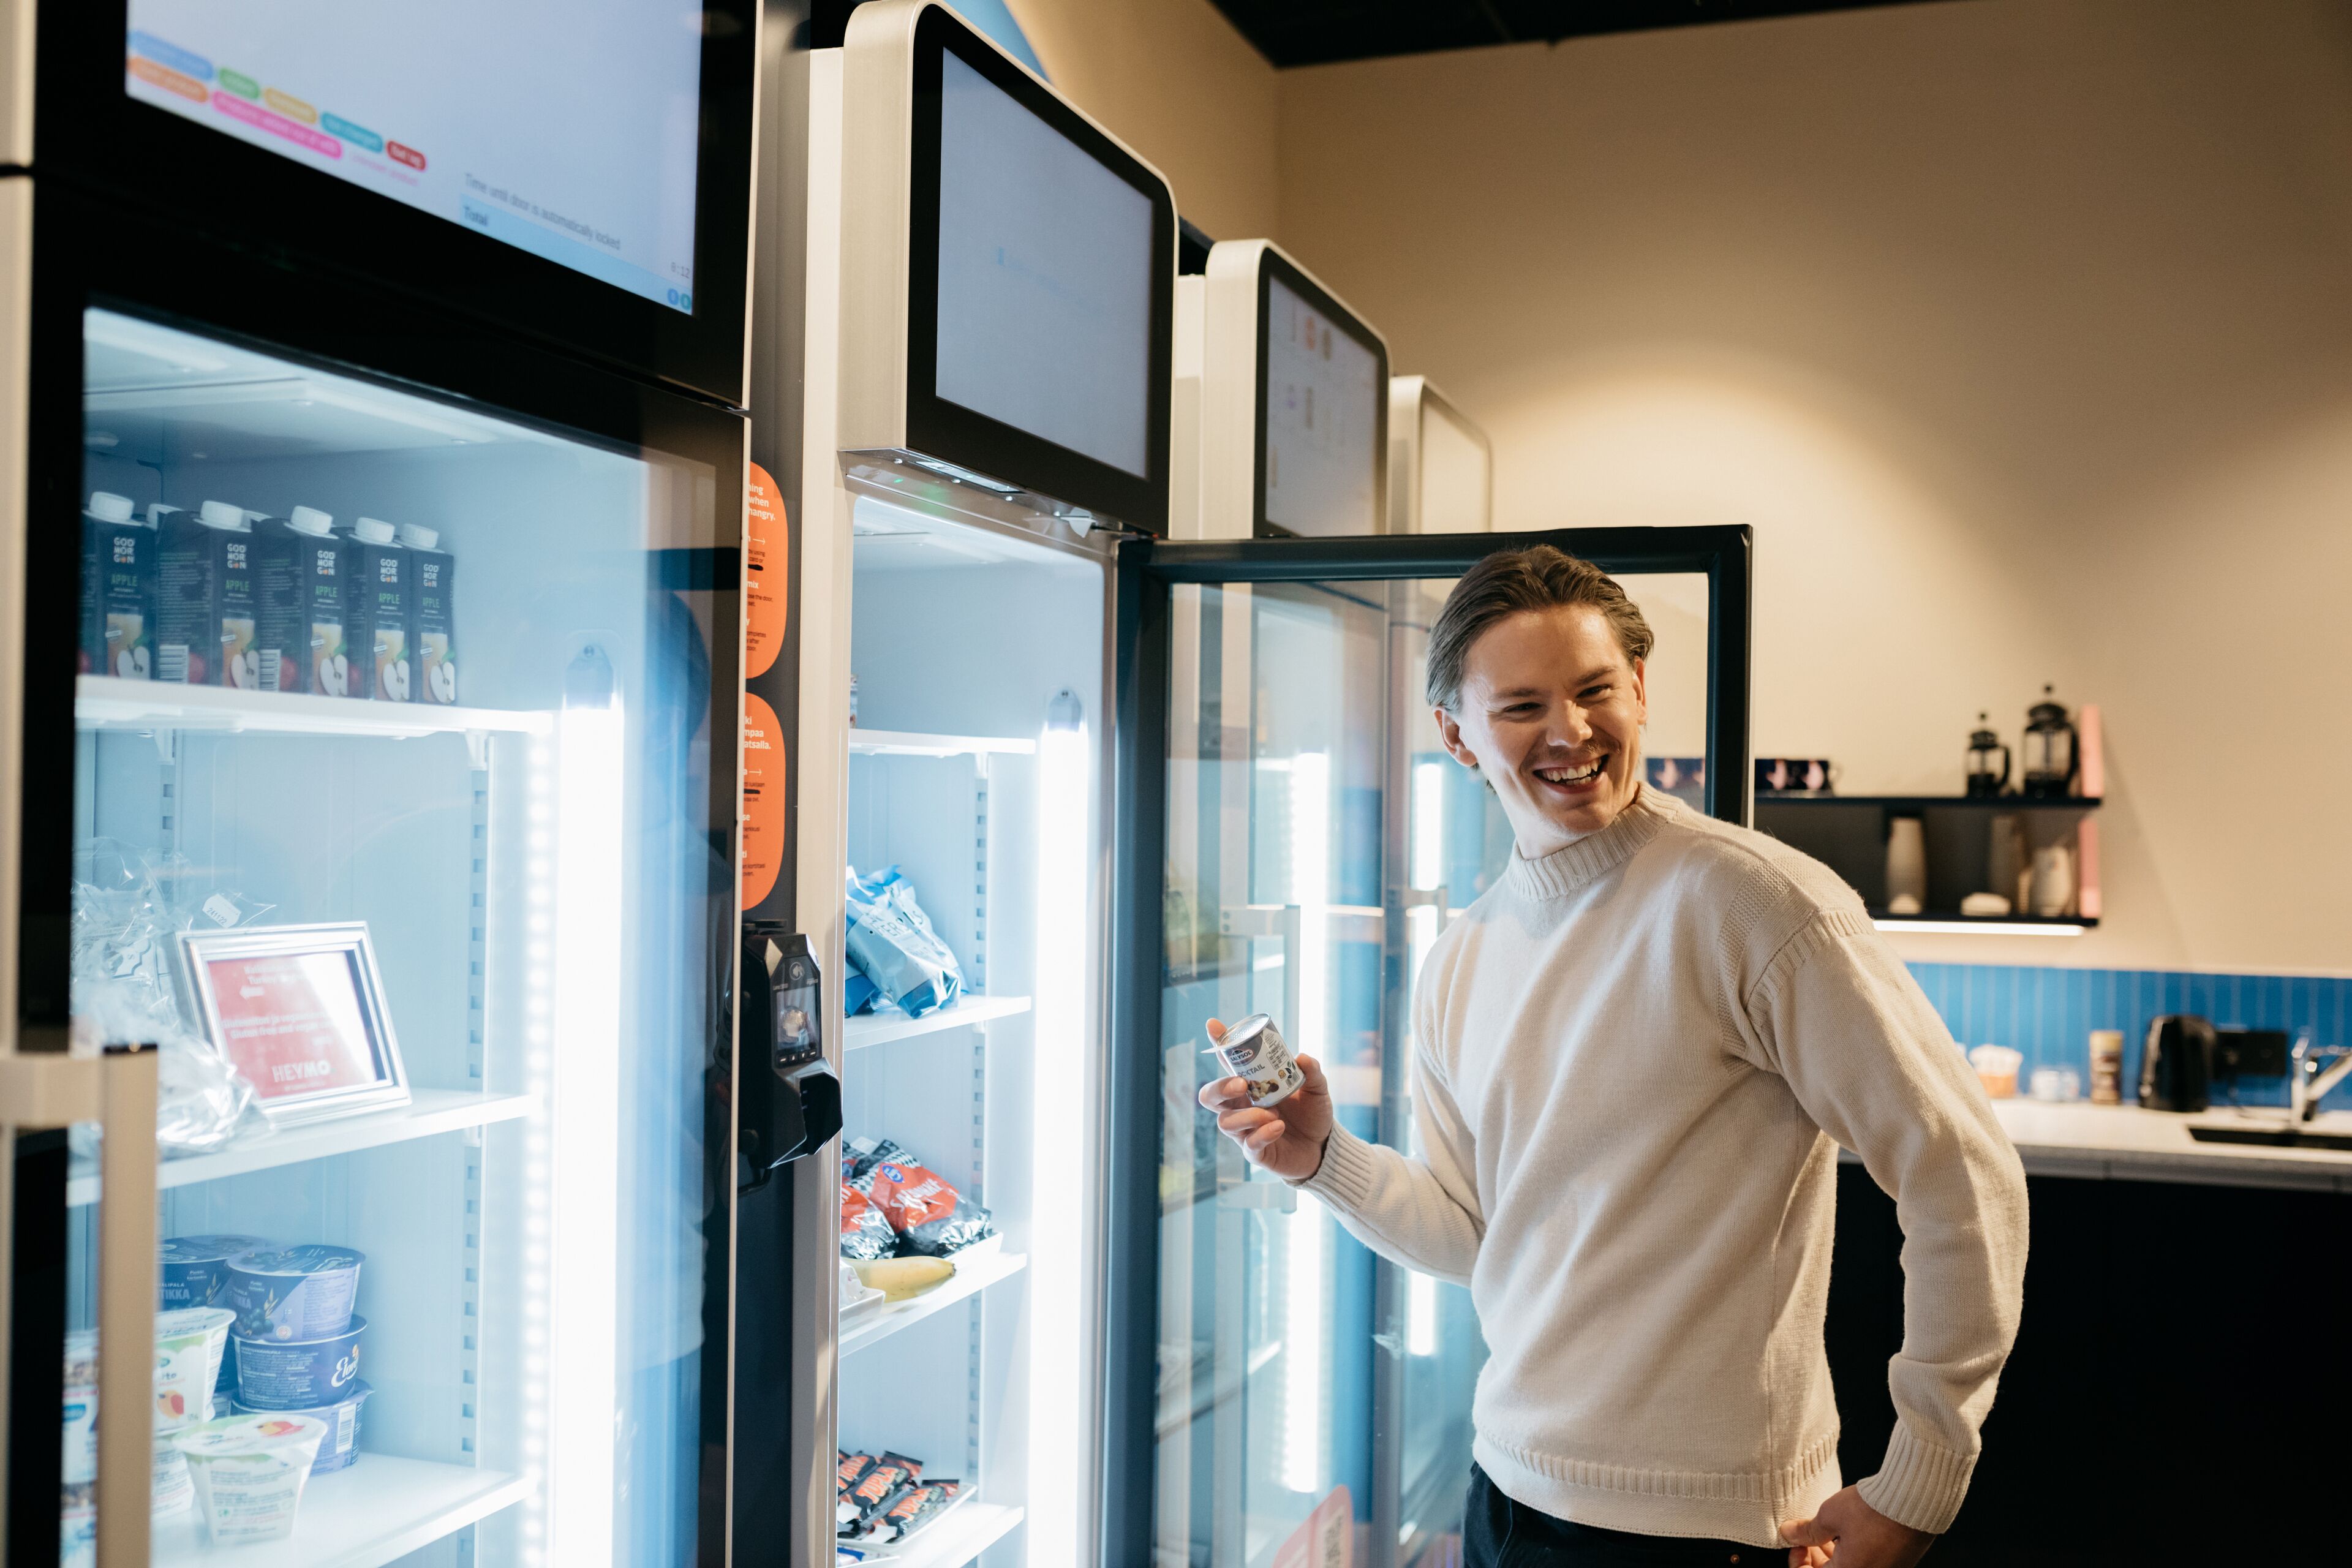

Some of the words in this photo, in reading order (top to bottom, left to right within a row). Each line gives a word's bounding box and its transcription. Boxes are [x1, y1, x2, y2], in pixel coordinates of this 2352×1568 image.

[464, 204, 488, 227] Total
[465, 172, 487, 194] Time
[490, 183, 508, 204] until
[510, 192, 530, 213] door
[532, 202, 540, 216] is
[541, 206, 594, 242] automatically
[596, 229, 621, 251] locked
[113, 537, 135, 547] GOD
[113, 546, 135, 555] MOR
[227, 543, 247, 552] GOD
[227, 552, 246, 562] MOR
[317, 550, 336, 560] GOD
[317, 559, 335, 568] MOR
[380, 558, 398, 568] GOD
[380, 567, 398, 575] MOR
[423, 564, 439, 573] GOD
[111, 573, 138, 587] APPLE
[423, 571, 438, 580] MOR
[225, 579, 250, 592] APPLE
[315, 585, 338, 598] APPLE
[379, 592, 401, 605] APPLE
[422, 597, 441, 609] APPLE
[856, 1466, 899, 1504] TUPLA
[888, 1487, 933, 1521] TUPLA
